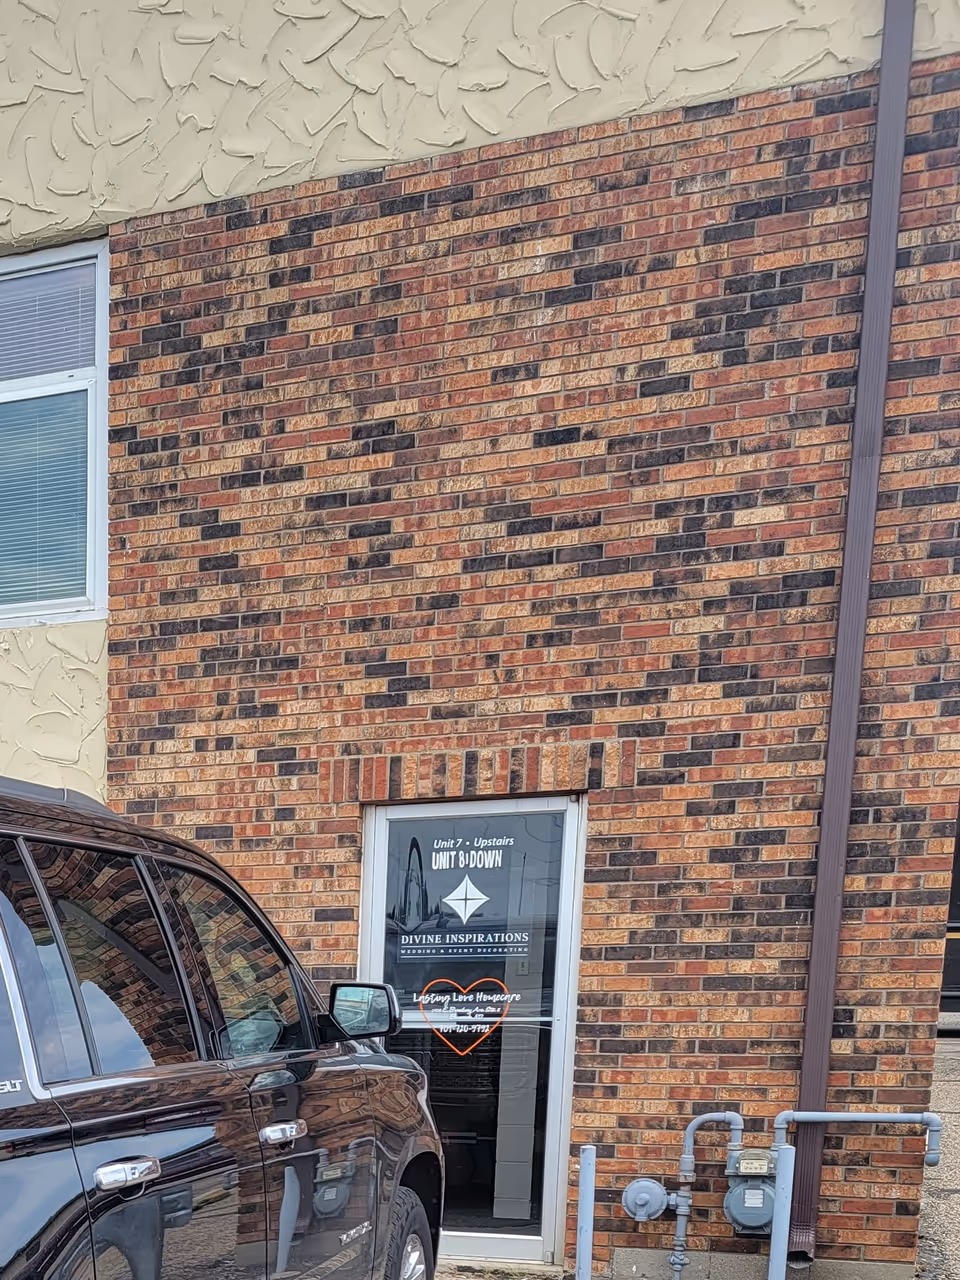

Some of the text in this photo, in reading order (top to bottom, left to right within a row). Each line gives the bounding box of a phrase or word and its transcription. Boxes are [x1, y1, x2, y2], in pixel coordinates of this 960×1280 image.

[433, 835, 515, 849] Unit 7 Upstairs
[431, 850, 457, 870] UNIT
[400, 932, 529, 945] DIVINE INSPIRATIONS
[413, 991, 522, 1010] Lasting Love Homecare
